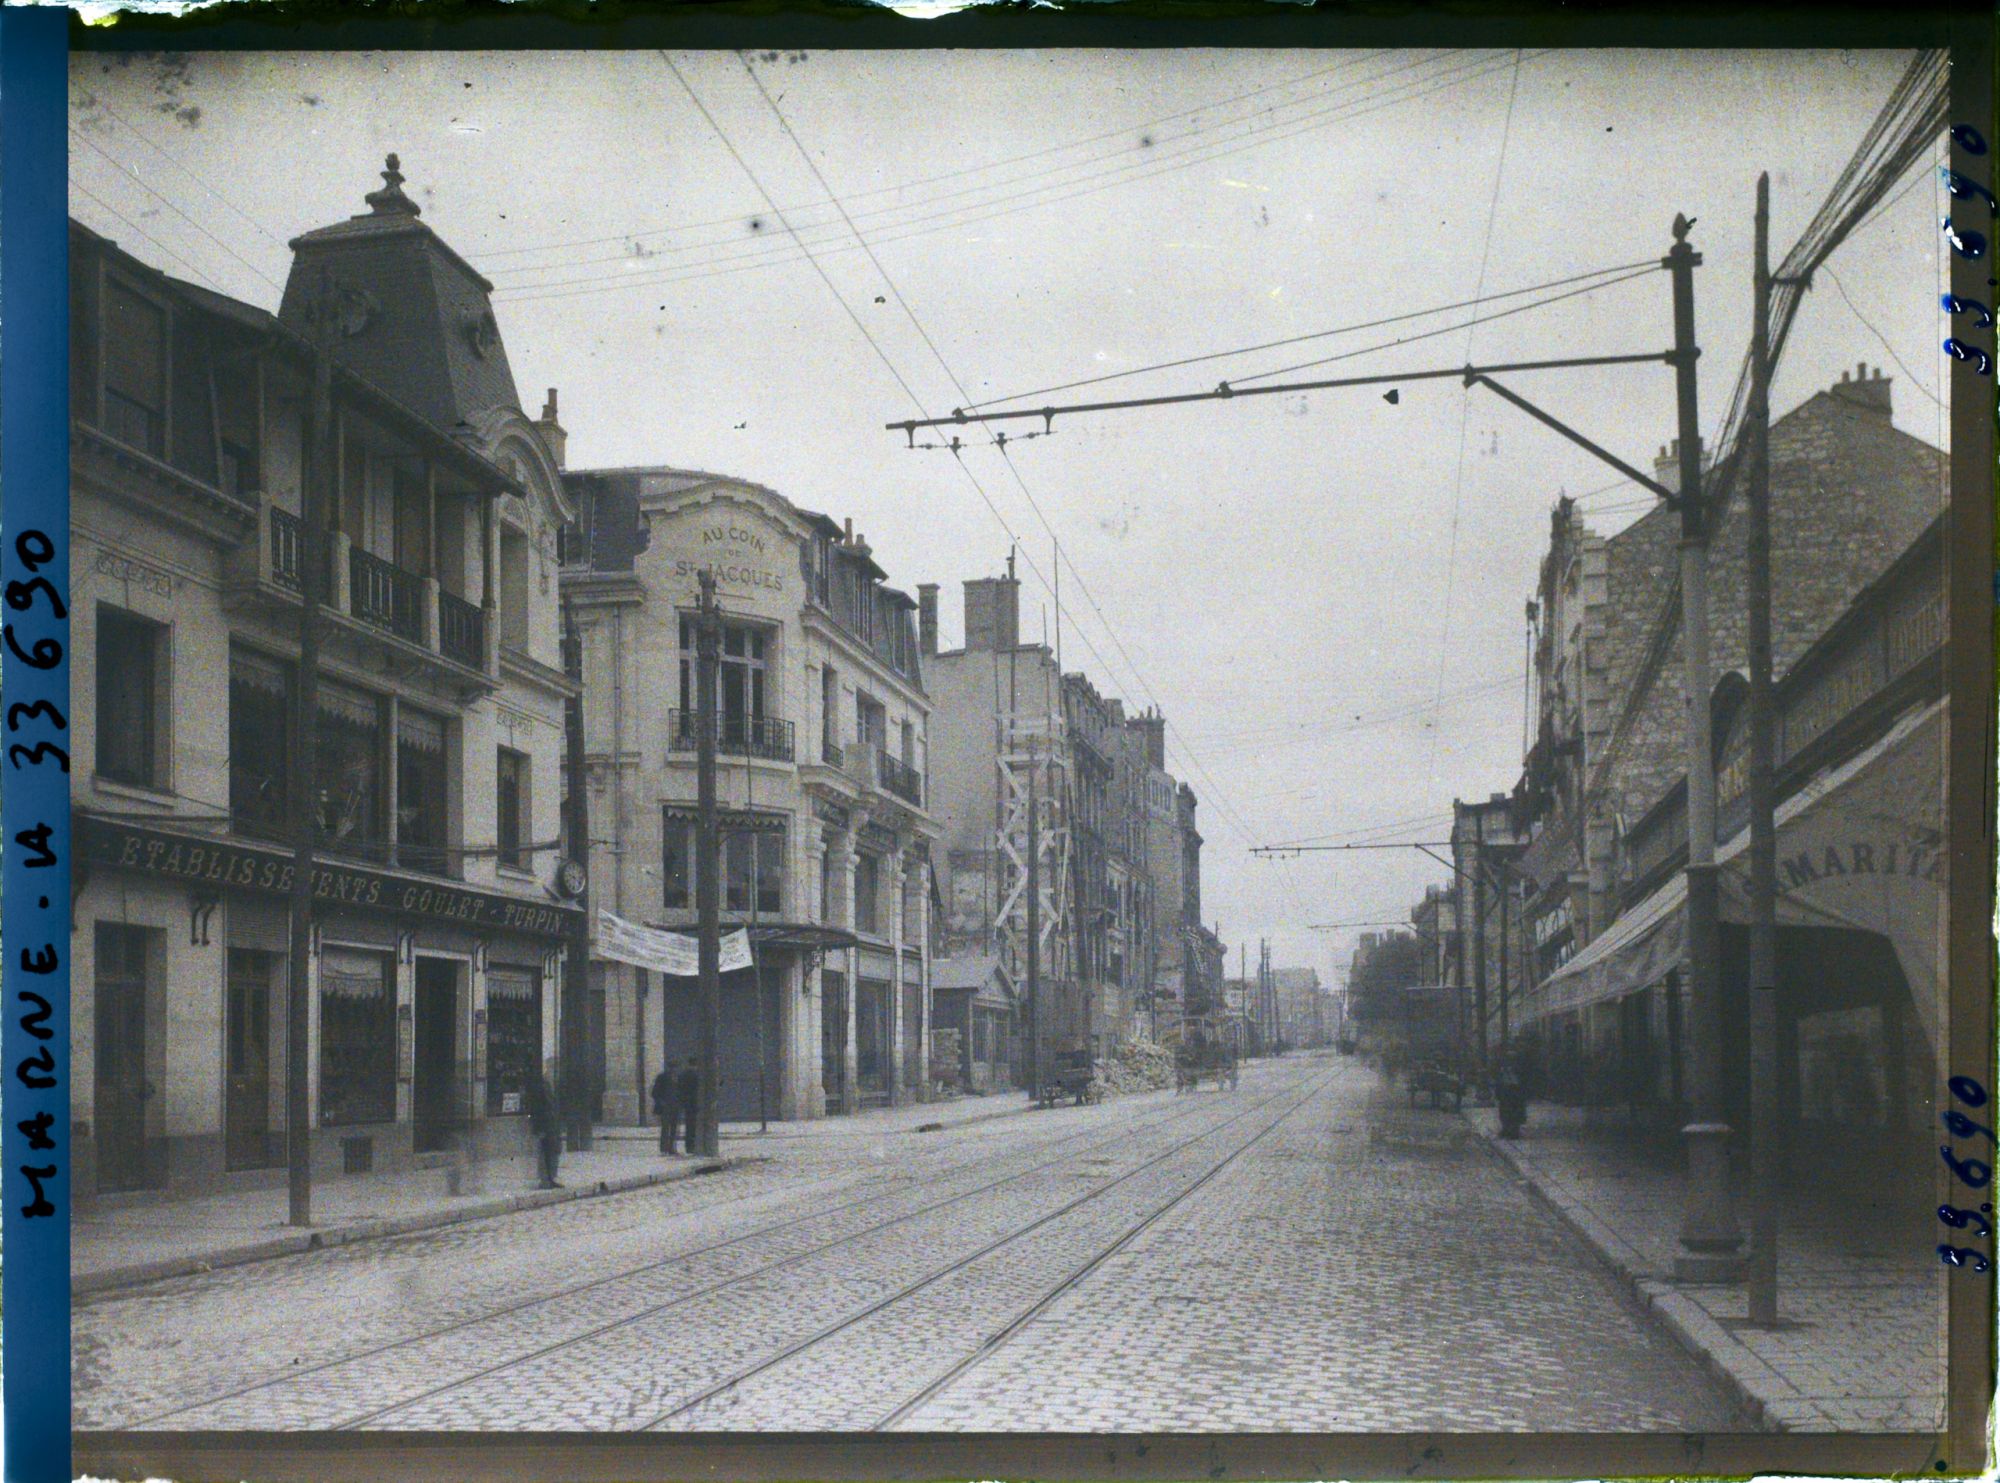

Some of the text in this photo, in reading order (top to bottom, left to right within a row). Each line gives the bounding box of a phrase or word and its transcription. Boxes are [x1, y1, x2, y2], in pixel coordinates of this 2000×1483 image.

[702, 527, 766, 553] AU COIN
[728, 549, 742, 558] DE
[118, 835, 382, 906] ETABLISSEENTS
